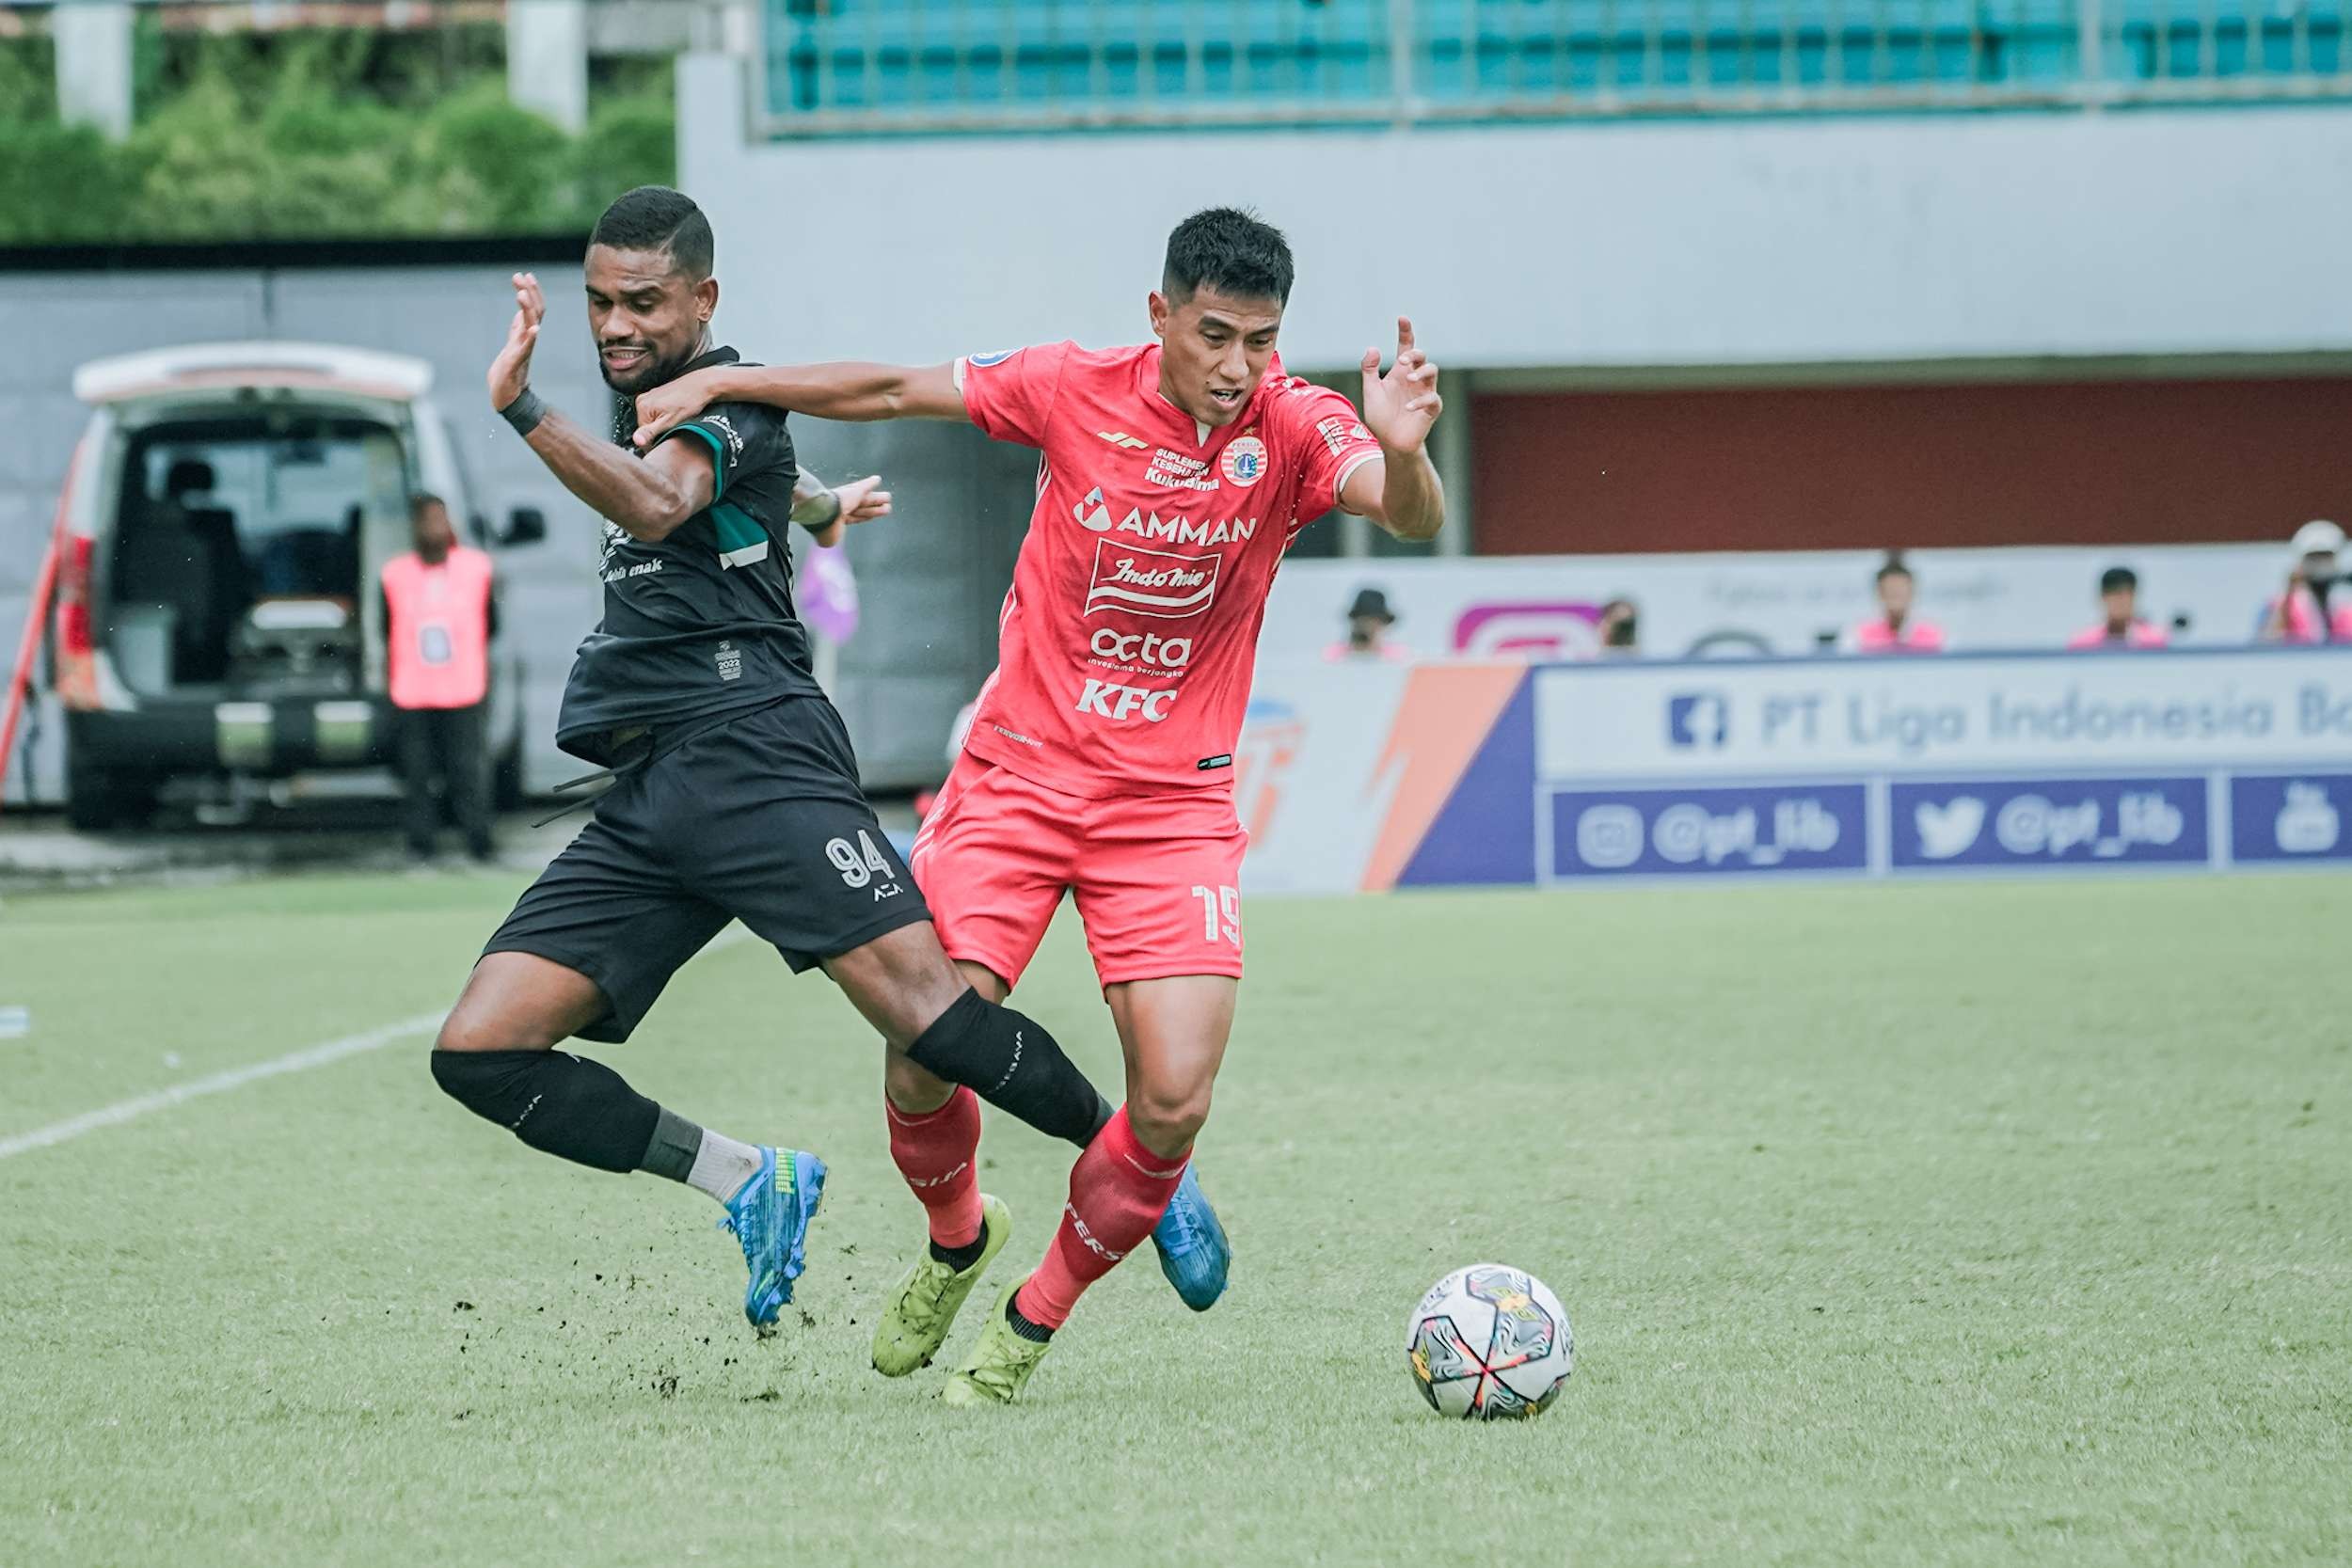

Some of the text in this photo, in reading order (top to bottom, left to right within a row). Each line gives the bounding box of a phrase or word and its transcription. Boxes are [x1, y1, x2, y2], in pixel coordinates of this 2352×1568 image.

[1116, 506, 1257, 547] AMMAN
[628, 557, 663, 578] enak
[717, 658, 740, 670] 2022
[1090, 627, 1193, 668] octa
[1074, 677, 1178, 723] KFC
[1759, 693, 1823, 744] PT
[1845, 689, 1966, 754] Liga
[1987, 687, 2271, 743] Indonesia
[825, 830, 896, 889] 94
[1191, 884, 1240, 948] 19
